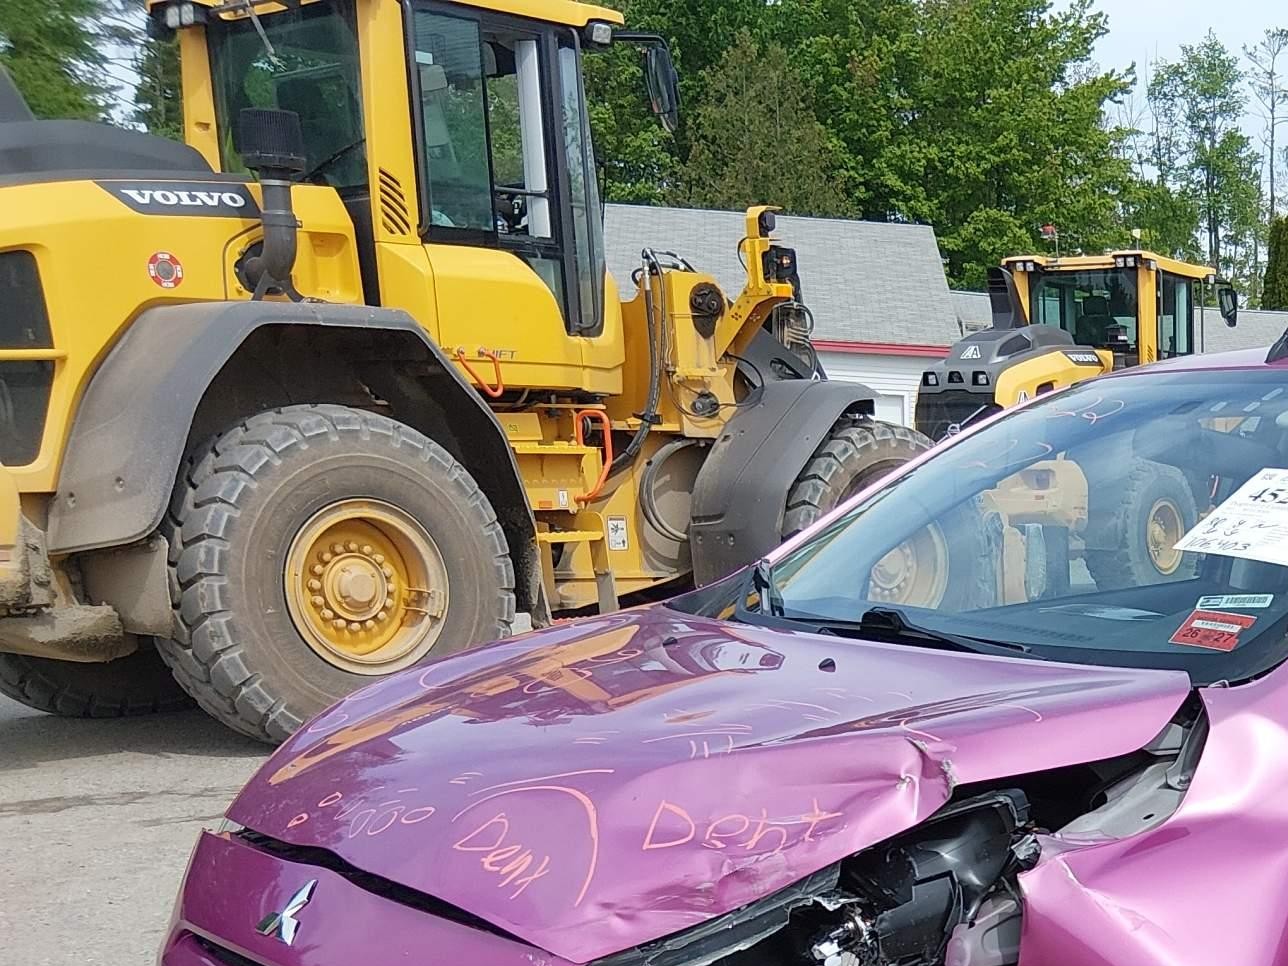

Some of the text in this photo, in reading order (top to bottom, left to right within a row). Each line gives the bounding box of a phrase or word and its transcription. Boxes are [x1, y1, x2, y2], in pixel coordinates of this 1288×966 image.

[120, 189, 246, 208] VOLVO
[1068, 354, 1099, 362] VOLVO
[1182, 628, 1235, 642] 26 27
